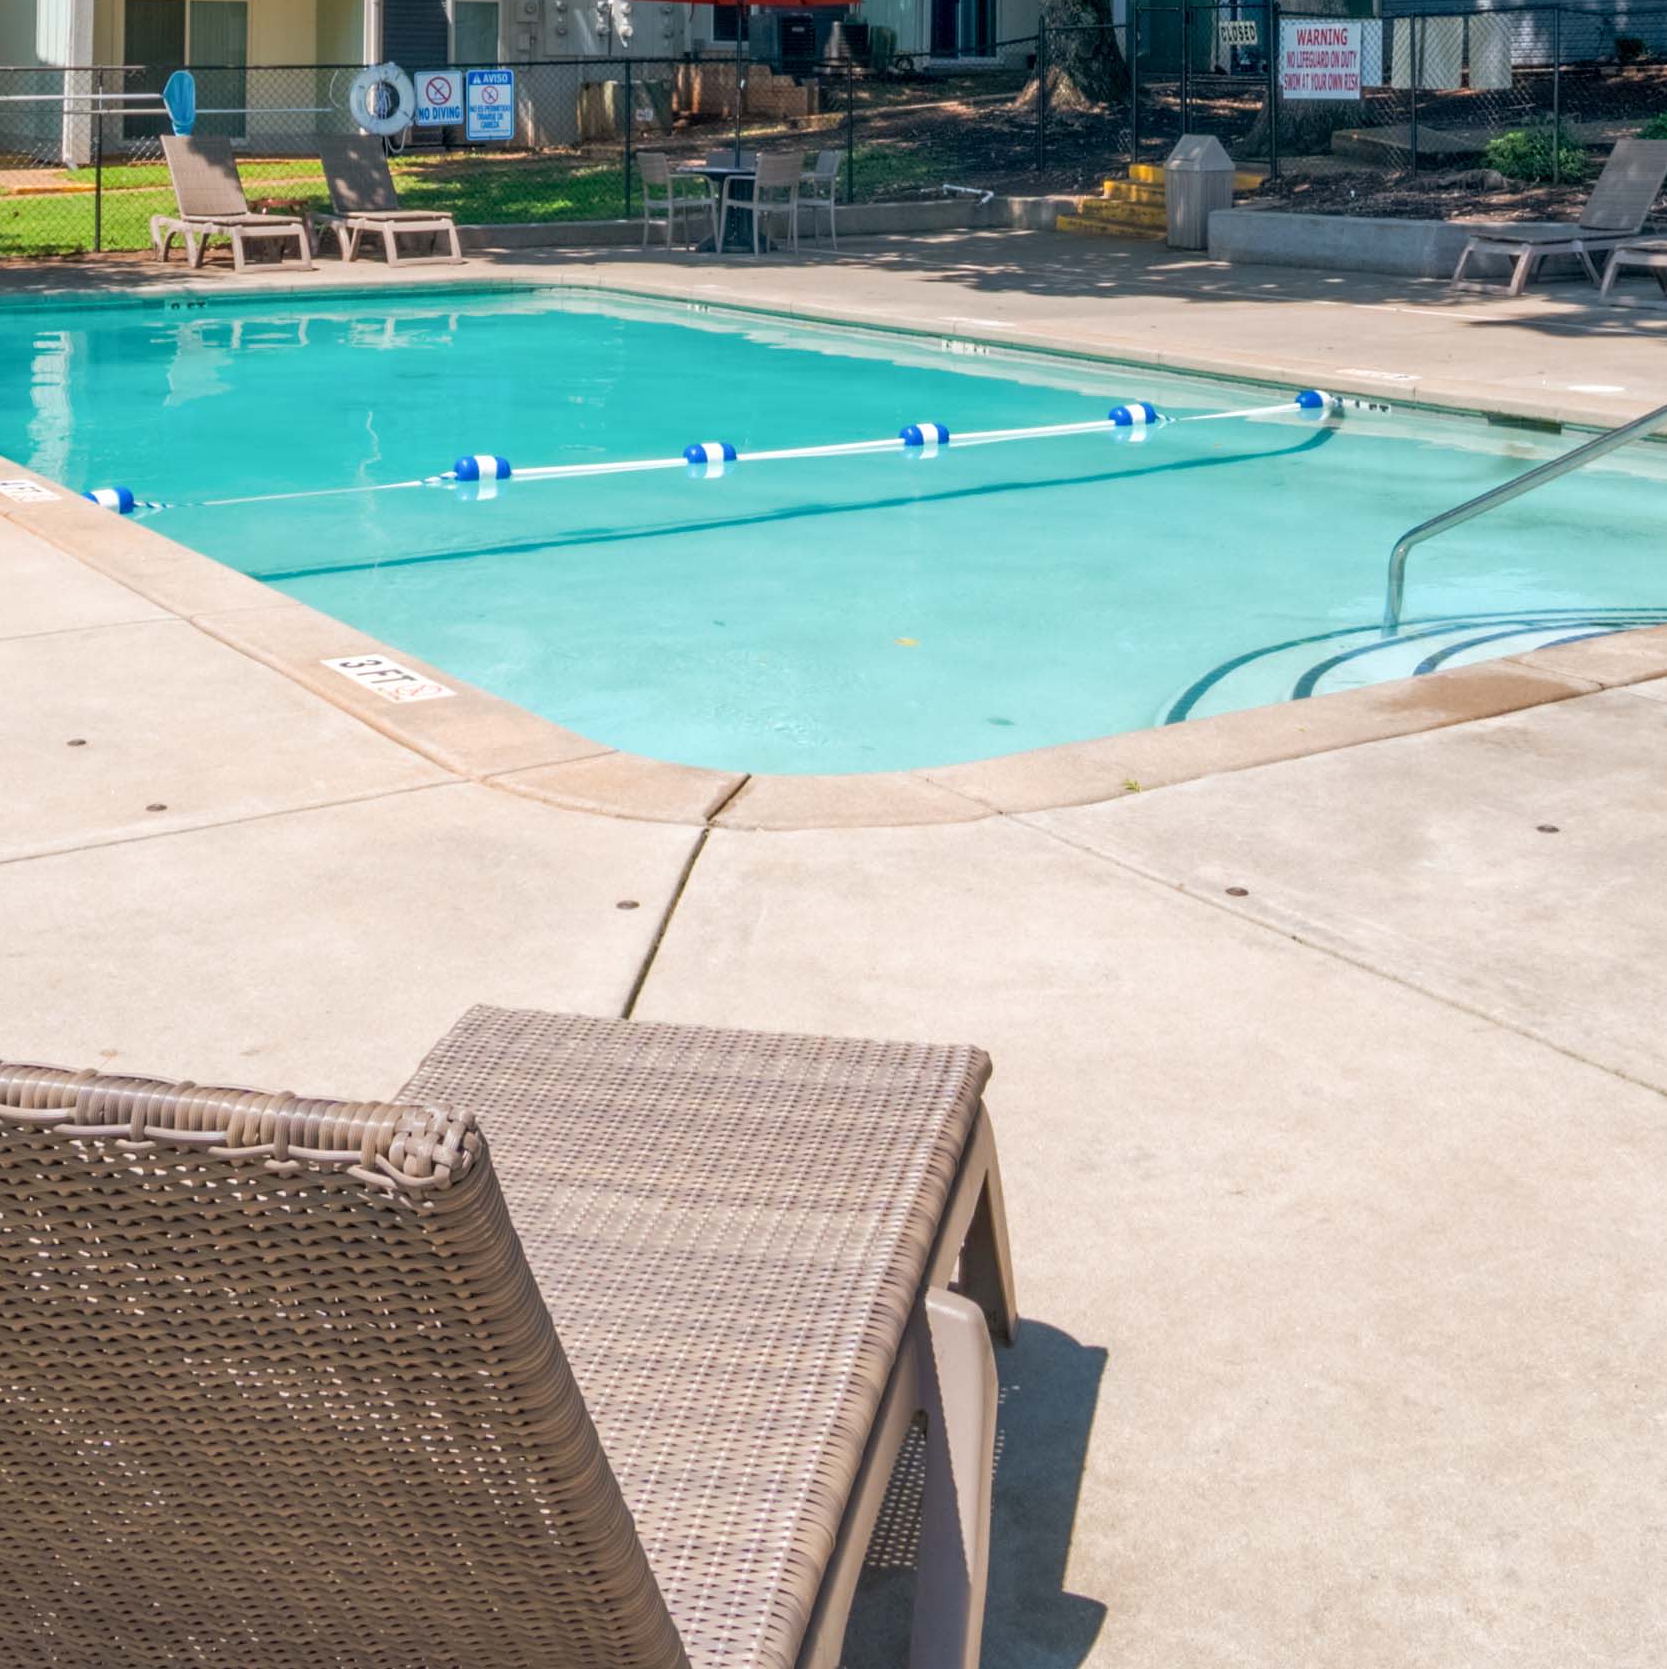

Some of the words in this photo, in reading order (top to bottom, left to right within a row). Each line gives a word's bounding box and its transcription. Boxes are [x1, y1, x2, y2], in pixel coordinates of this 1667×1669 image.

[1220, 24, 1256, 43] CLOSED
[1297, 28, 1349, 46] WARNING
[1286, 50, 1294, 69] NO
[1296, 50, 1329, 69] LIFEGUARD
[1330, 50, 1340, 69] ON
[1341, 50, 1358, 69] DUTY
[483, 74, 508, 83] AVISO
[1284, 73, 1301, 92] SWIM
[1302, 73, 1310, 91] AT
[1311, 73, 1327, 91] YOUR
[1328, 73, 1343, 91] OWN
[418, 107, 430, 120] NO
[432, 106, 460, 119] DIVING
[338, 659, 382, 669] 3
[356, 668, 418, 684] FT
